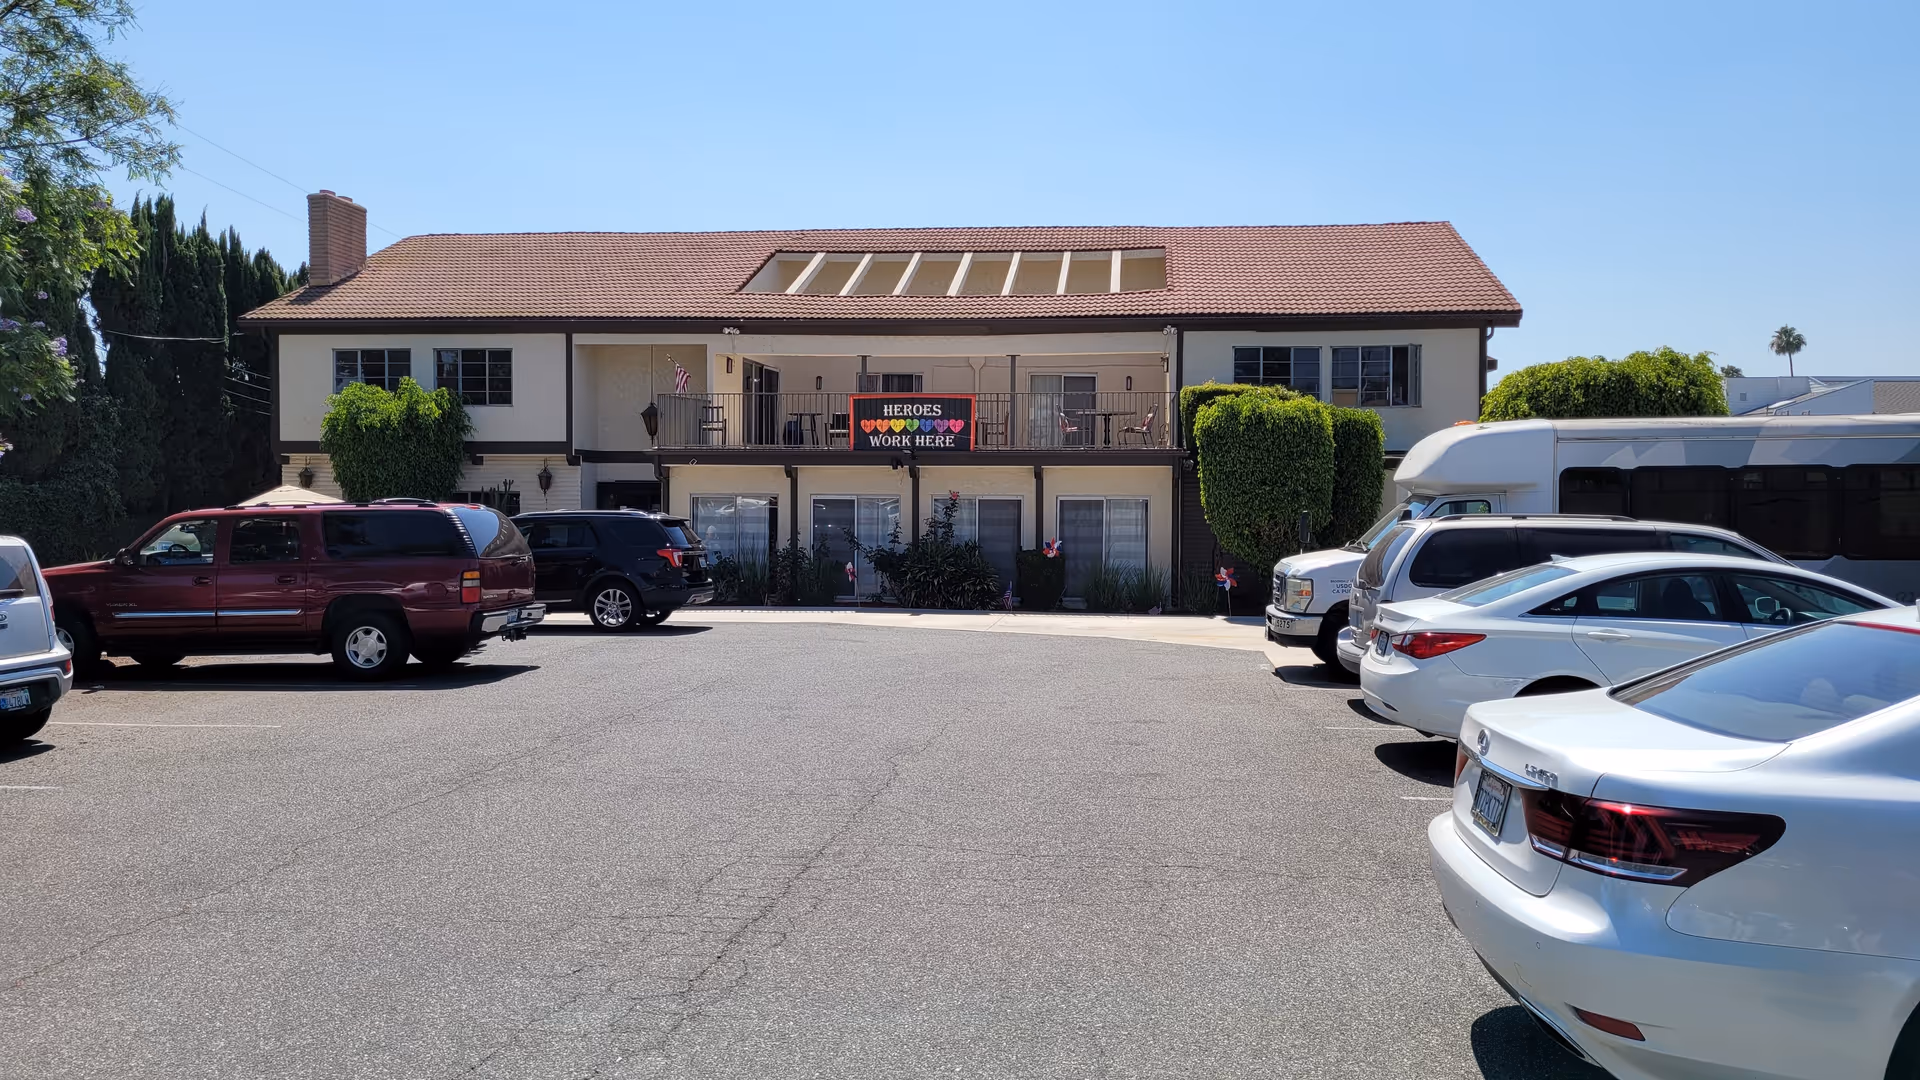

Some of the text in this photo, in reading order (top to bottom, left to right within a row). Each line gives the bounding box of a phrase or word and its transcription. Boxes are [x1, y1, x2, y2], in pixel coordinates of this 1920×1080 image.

[883, 404, 942, 417] HEROES
[869, 434, 955, 447] WORK HERE
[1277, 619, 1291, 629] 5275
